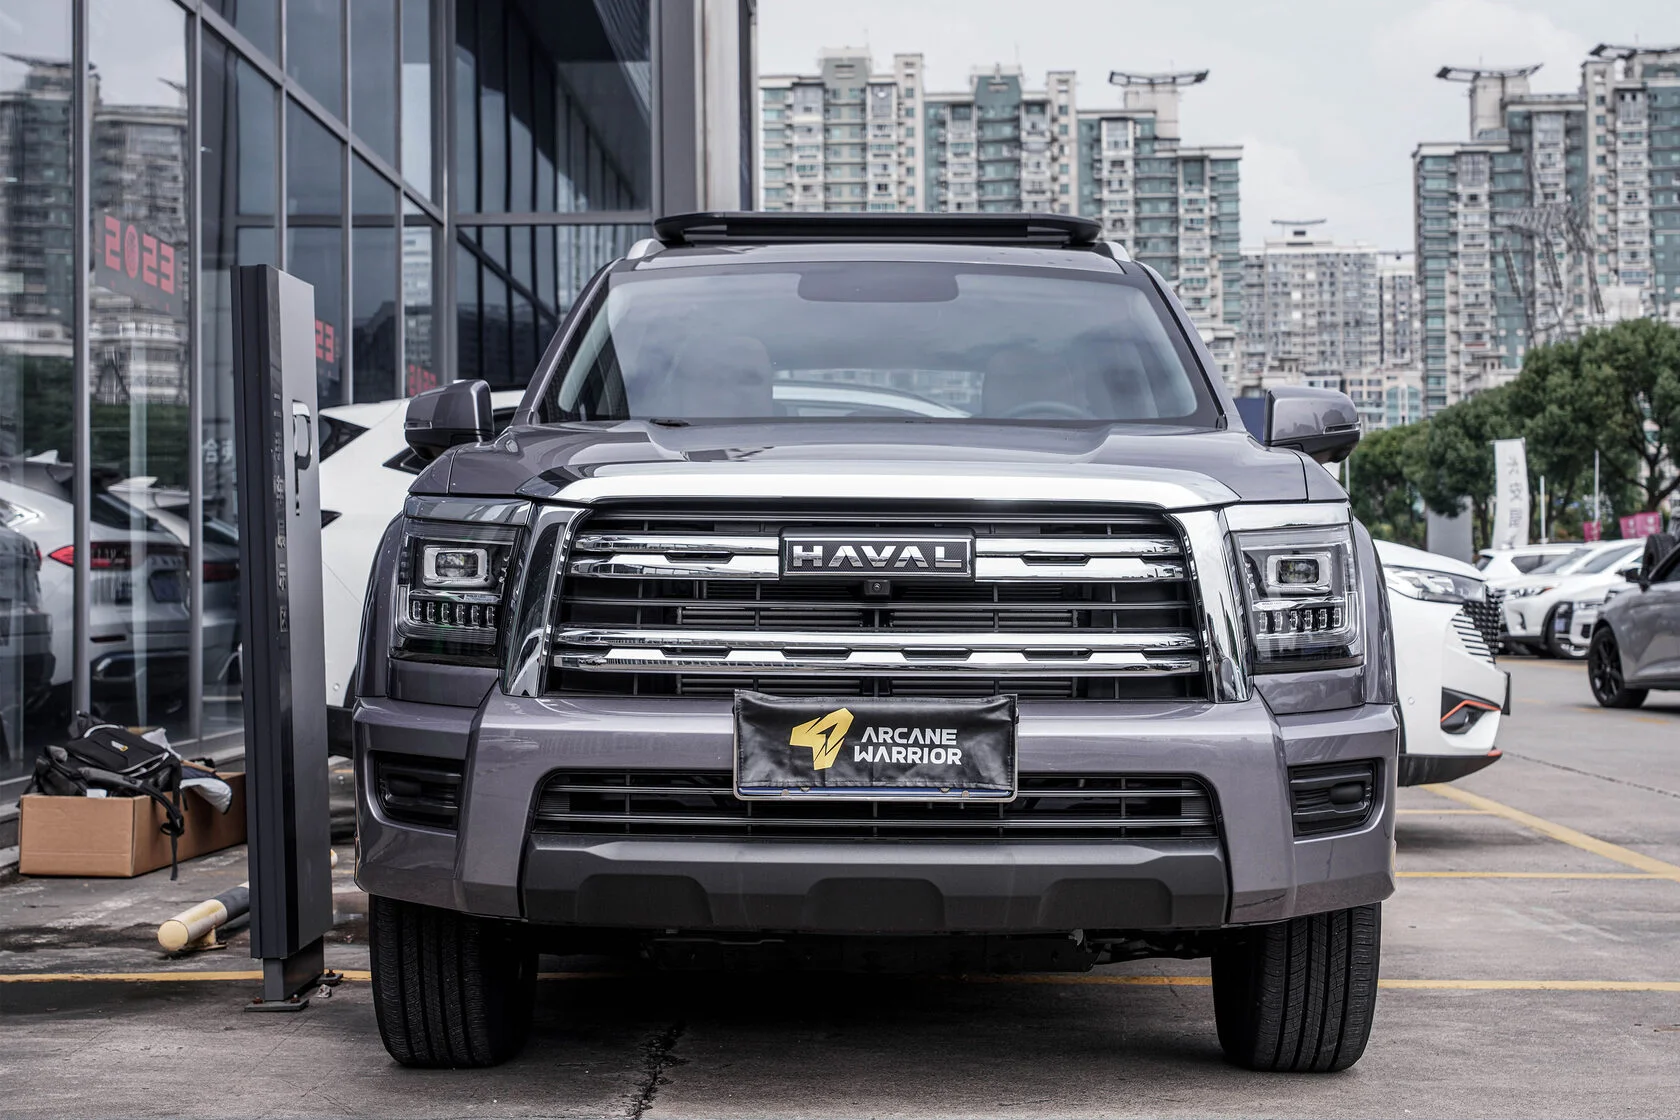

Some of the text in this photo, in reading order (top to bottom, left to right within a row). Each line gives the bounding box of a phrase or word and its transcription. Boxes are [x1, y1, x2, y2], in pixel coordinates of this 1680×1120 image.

[792, 545, 962, 568] HAVAL
[860, 726, 958, 745] ARCANE
[854, 745, 962, 765] WARRIOR
